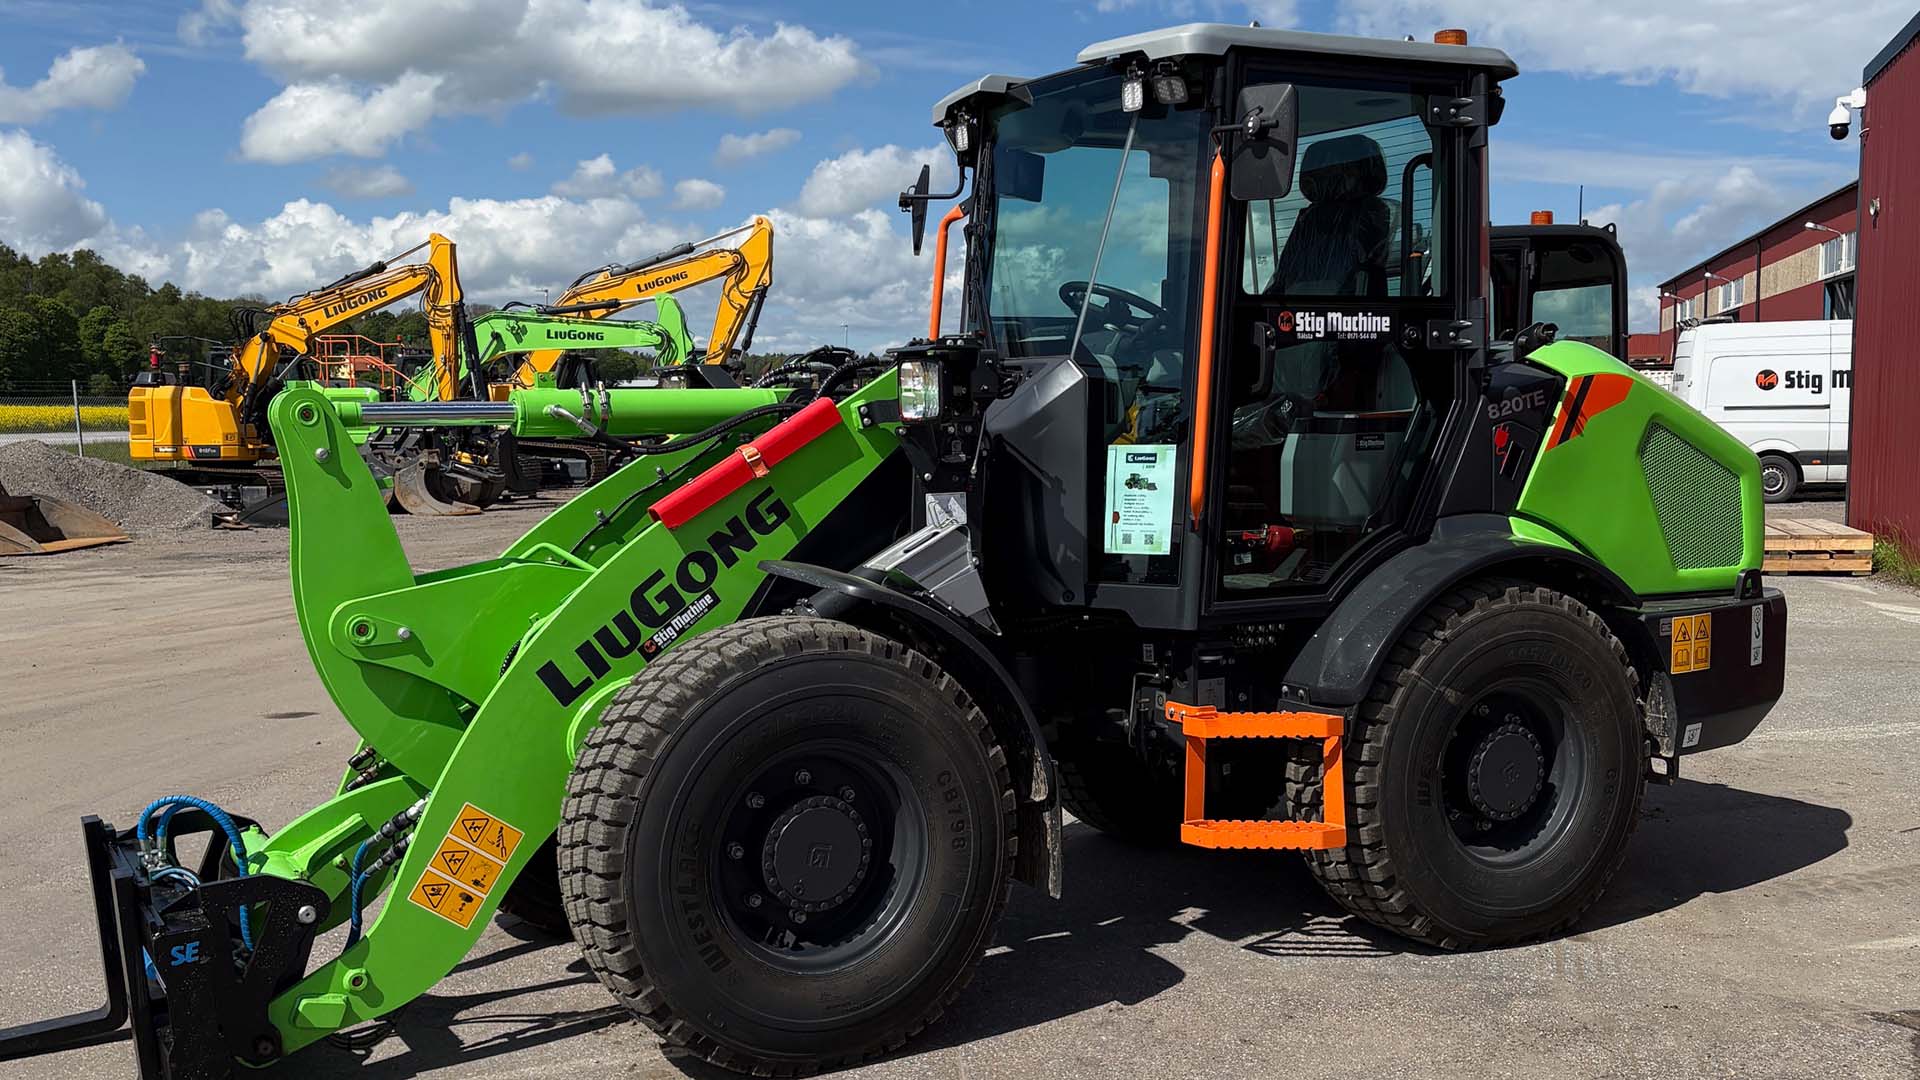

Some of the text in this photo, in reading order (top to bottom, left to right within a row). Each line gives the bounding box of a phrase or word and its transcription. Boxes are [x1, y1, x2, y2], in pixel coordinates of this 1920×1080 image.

[1295, 311, 1391, 337] Stig Machine
[1785, 370, 1823, 394] Stig
[1487, 390, 1546, 419] 820TE
[653, 627, 678, 646] Stig
[671, 594, 714, 631] Machine
[171, 941, 200, 967] SE
